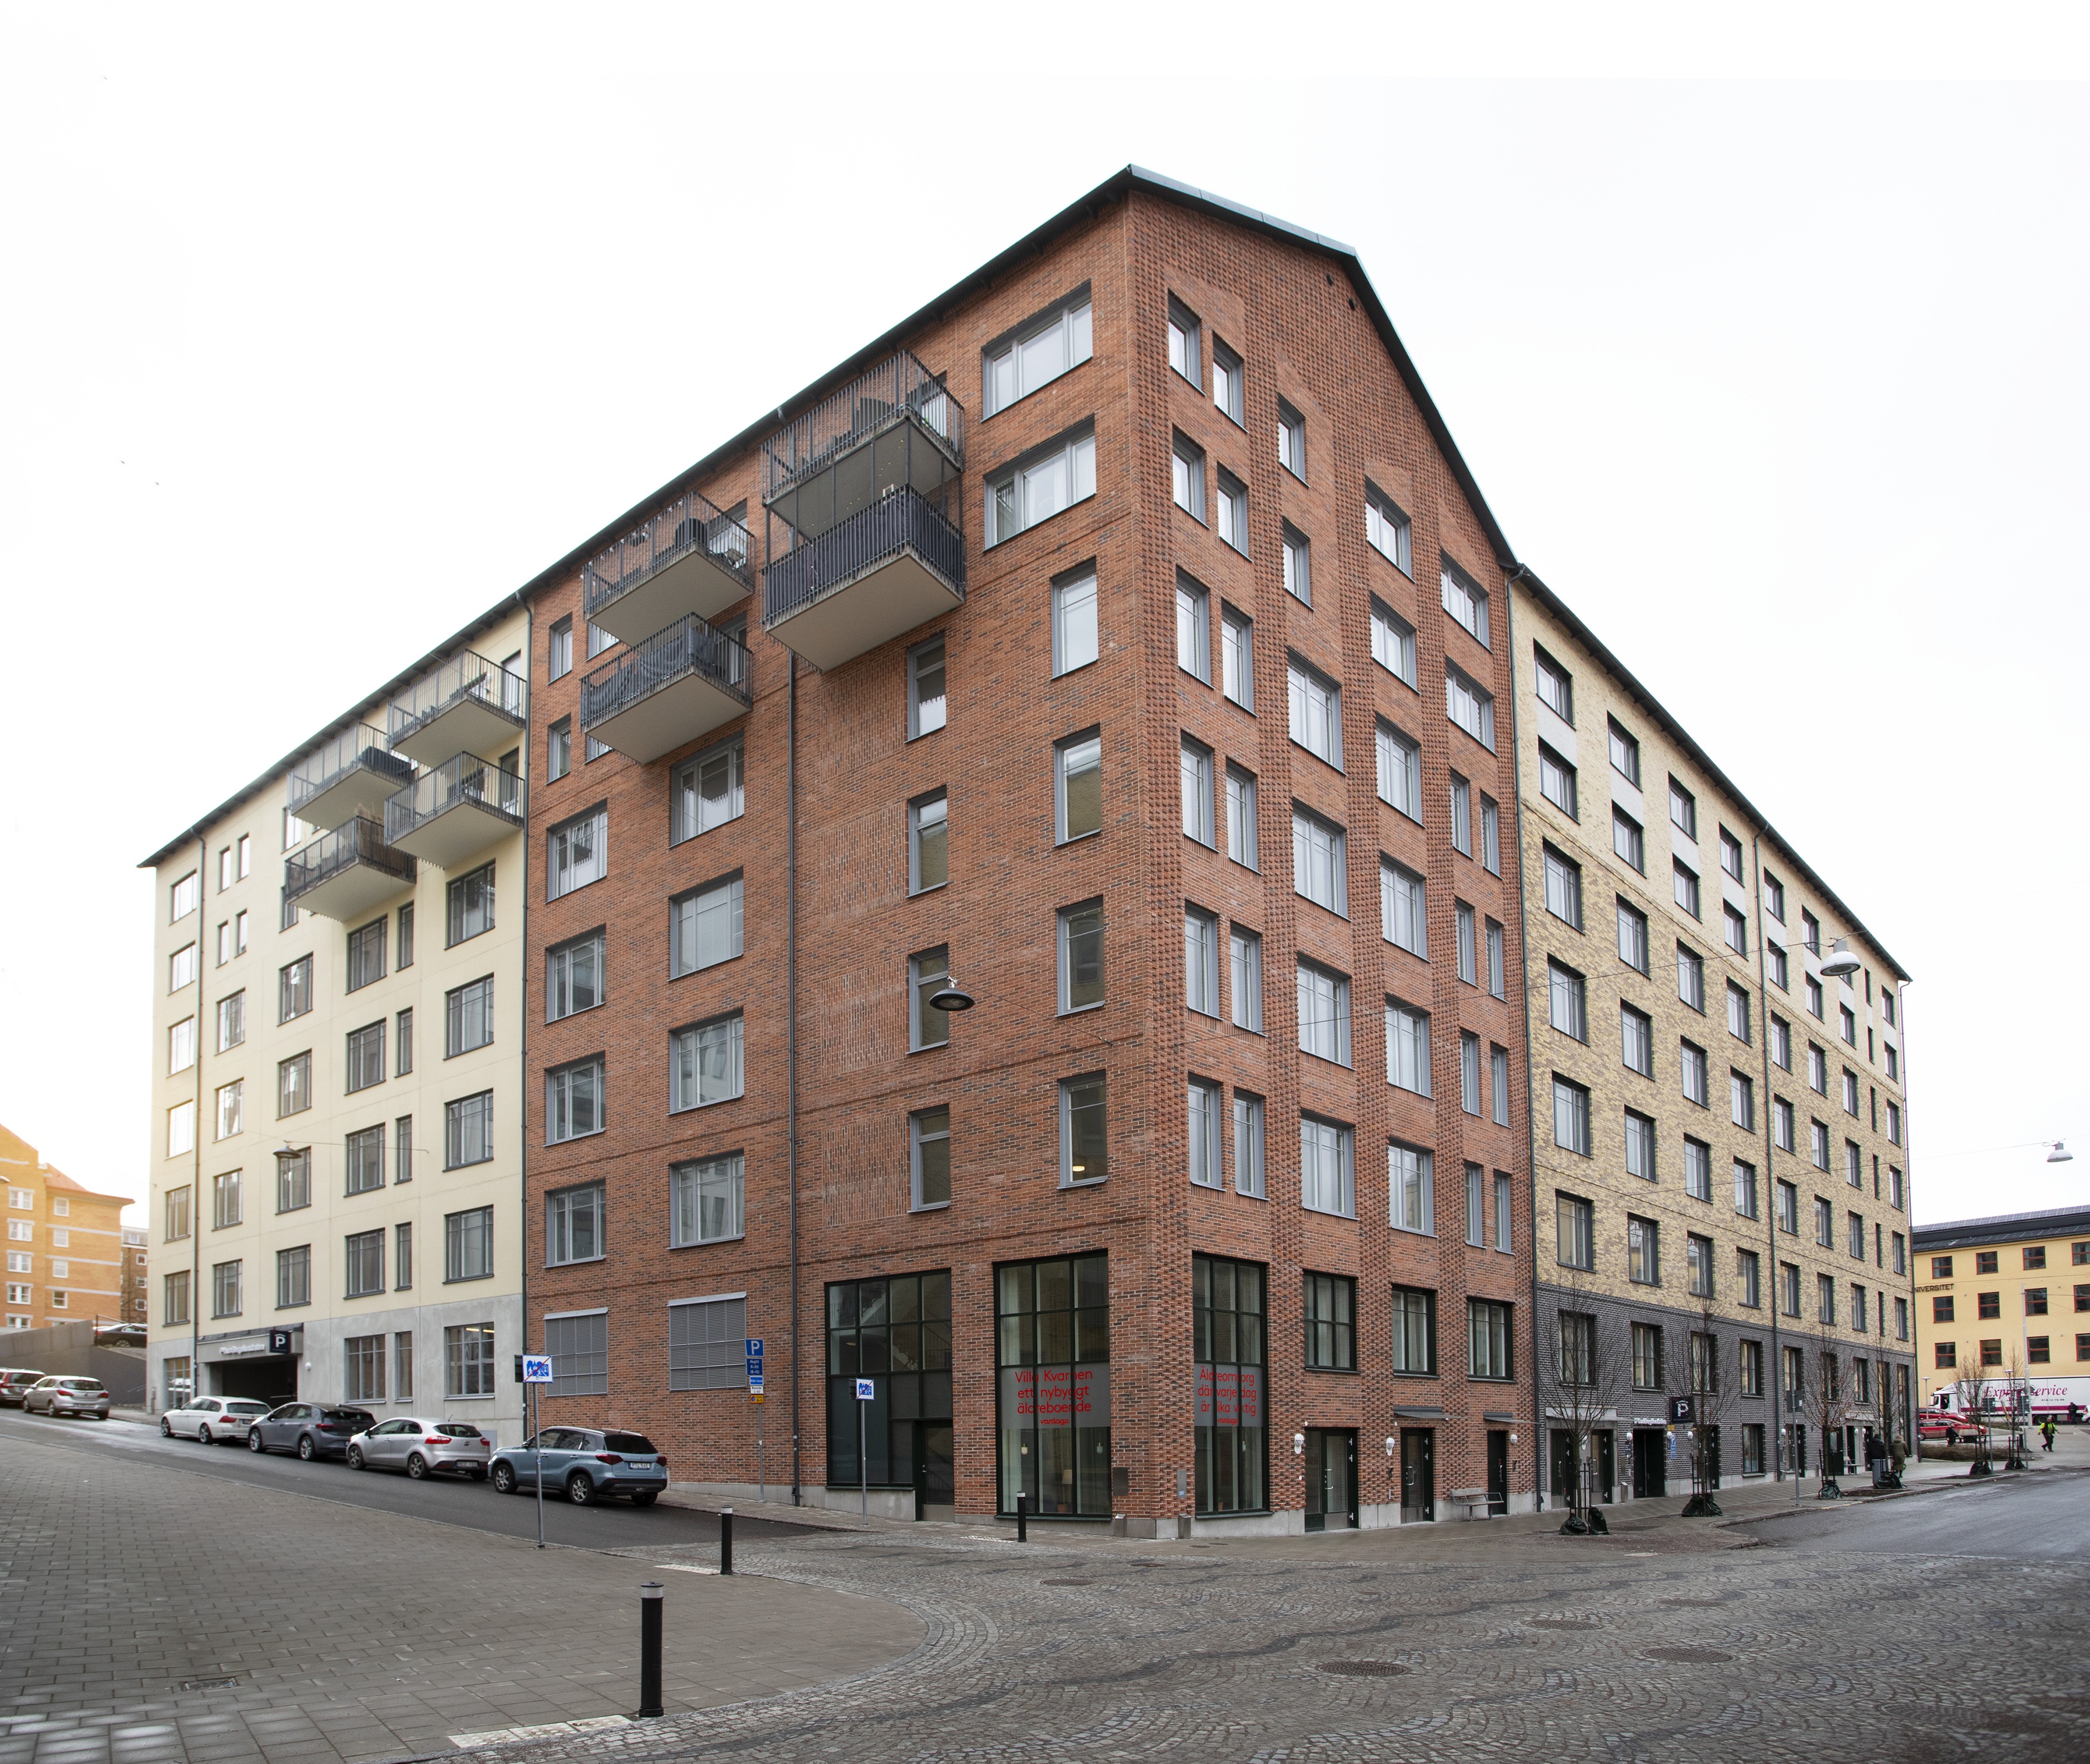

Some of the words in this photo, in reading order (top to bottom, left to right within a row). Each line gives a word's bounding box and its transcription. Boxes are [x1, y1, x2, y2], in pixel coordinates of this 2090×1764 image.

[275, 1336, 286, 1348] P
[751, 1340, 760, 1355] P
[1015, 1371, 1039, 1382] Villa
[1017, 1387, 1034, 1398] ett
[1198, 1384, 1214, 1396] där
[1216, 1385, 1237, 1401] varje
[1241, 1386, 1257, 1402] dag
[1201, 1401, 1210, 1412] är
[1216, 1401, 1230, 1413] lika
[1678, 1403, 1689, 1417] P
[1040, 1417, 1069, 1426] vardaga
